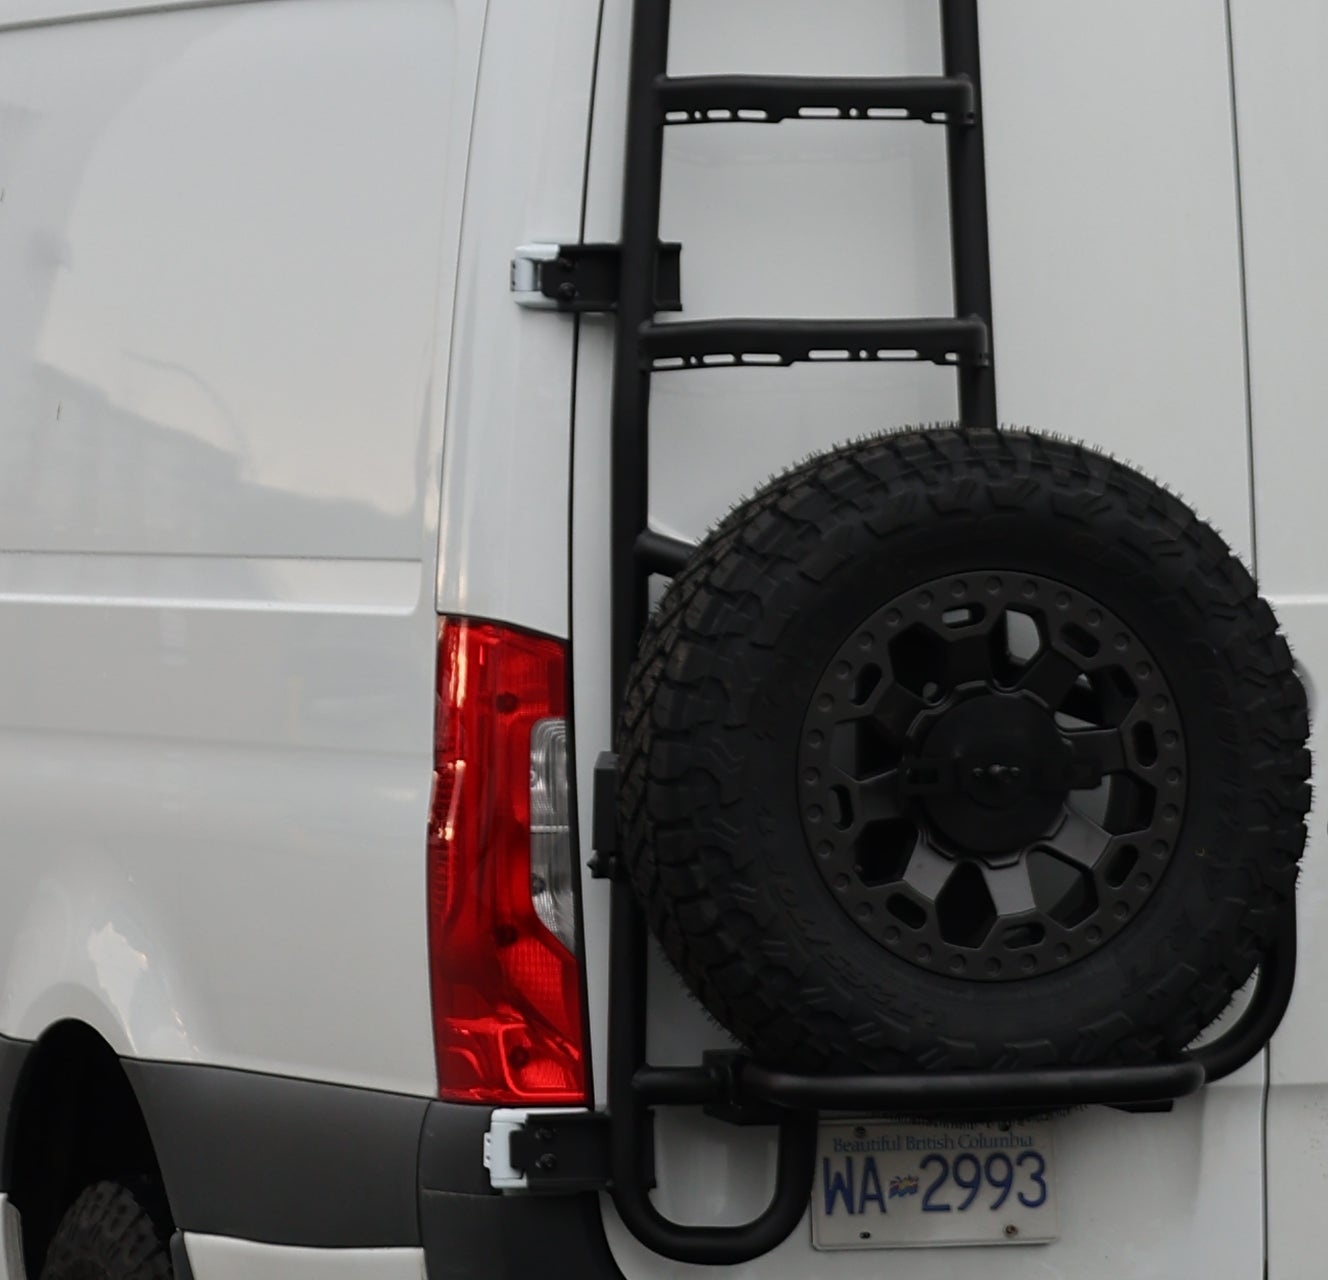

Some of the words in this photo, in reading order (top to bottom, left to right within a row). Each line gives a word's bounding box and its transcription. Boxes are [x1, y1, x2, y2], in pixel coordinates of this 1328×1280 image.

[833, 1135, 901, 1153] Beautiful
[906, 1134, 953, 1150] British
[957, 1131, 1033, 1149] Columbia
[824, 1157, 886, 1215] WA
[919, 1151, 1047, 1212] 2993
